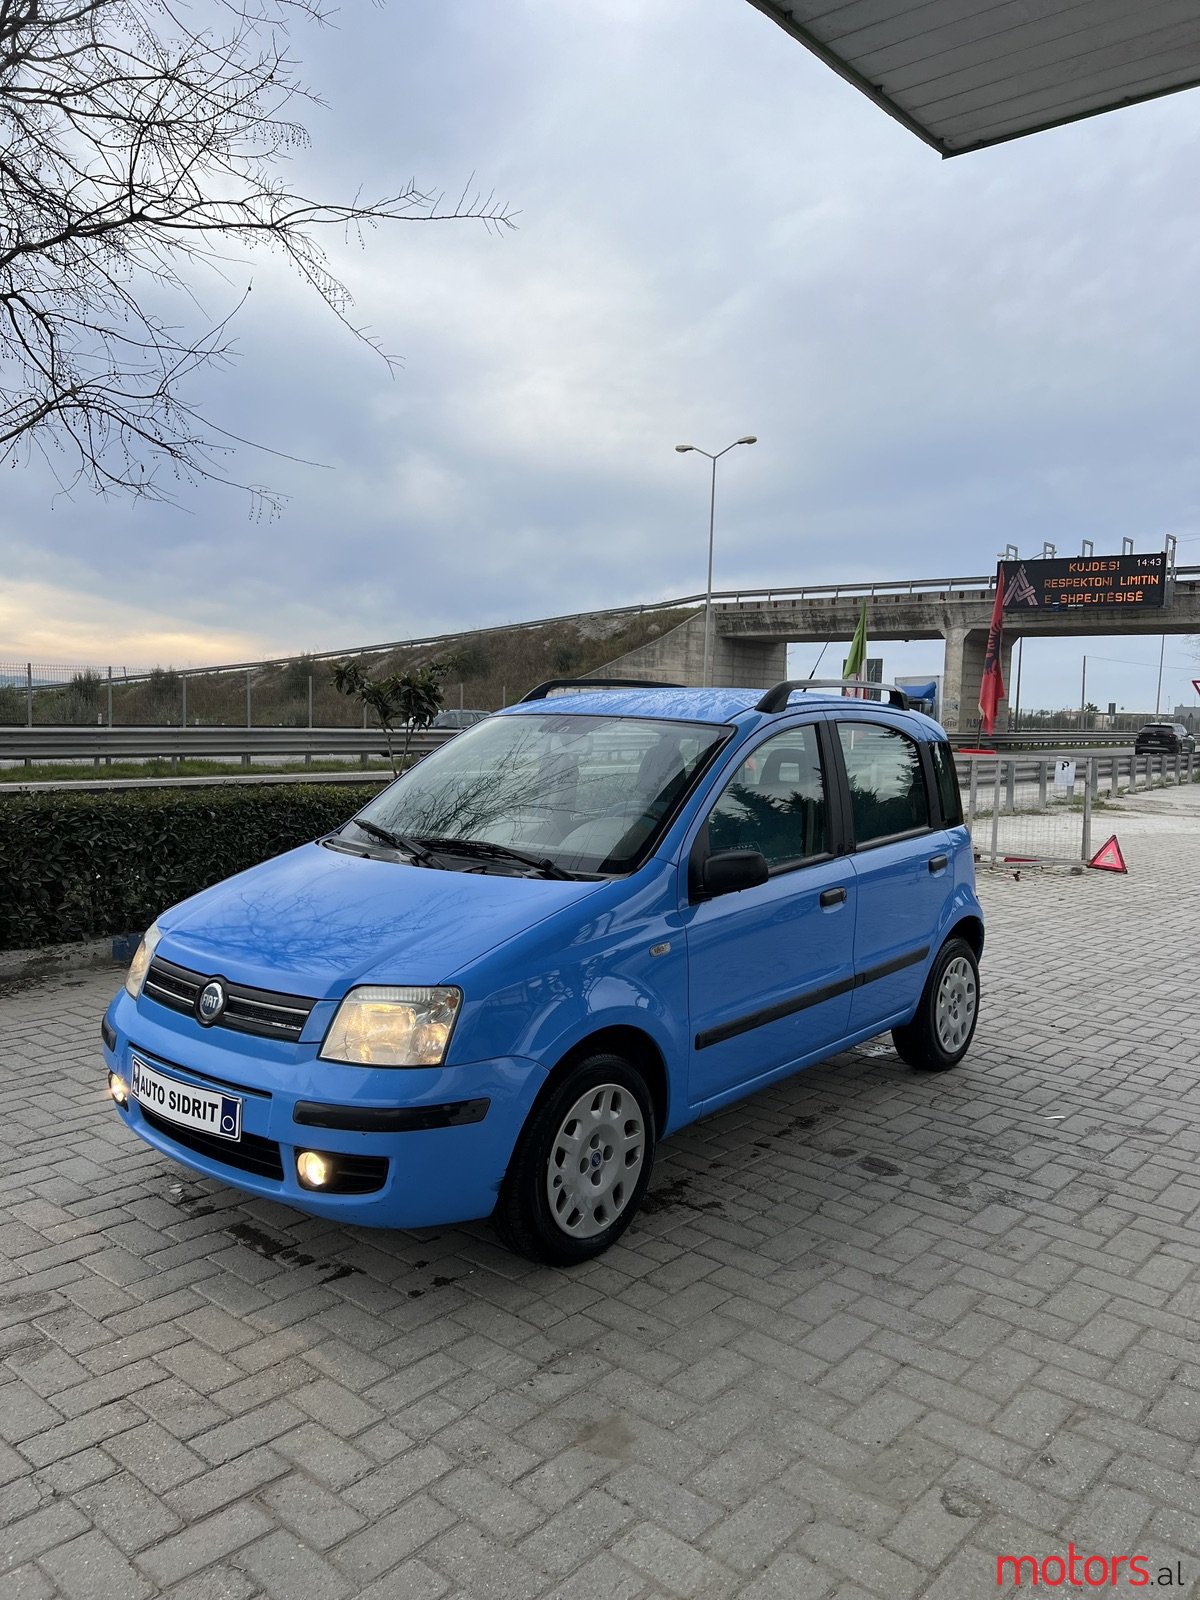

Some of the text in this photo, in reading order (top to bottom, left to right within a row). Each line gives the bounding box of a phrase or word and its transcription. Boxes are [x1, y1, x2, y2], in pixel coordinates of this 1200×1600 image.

[1069, 561, 1120, 573] KUJDES!
[1136, 558, 1162, 567] 14:43
[1044, 575, 1159, 588] RESPEKTONI LIMITIN
[1061, 761, 1070, 770] P
[201, 993, 218, 1009] FIAT
[140, 1075, 219, 1122] AUTO SIDRIT
